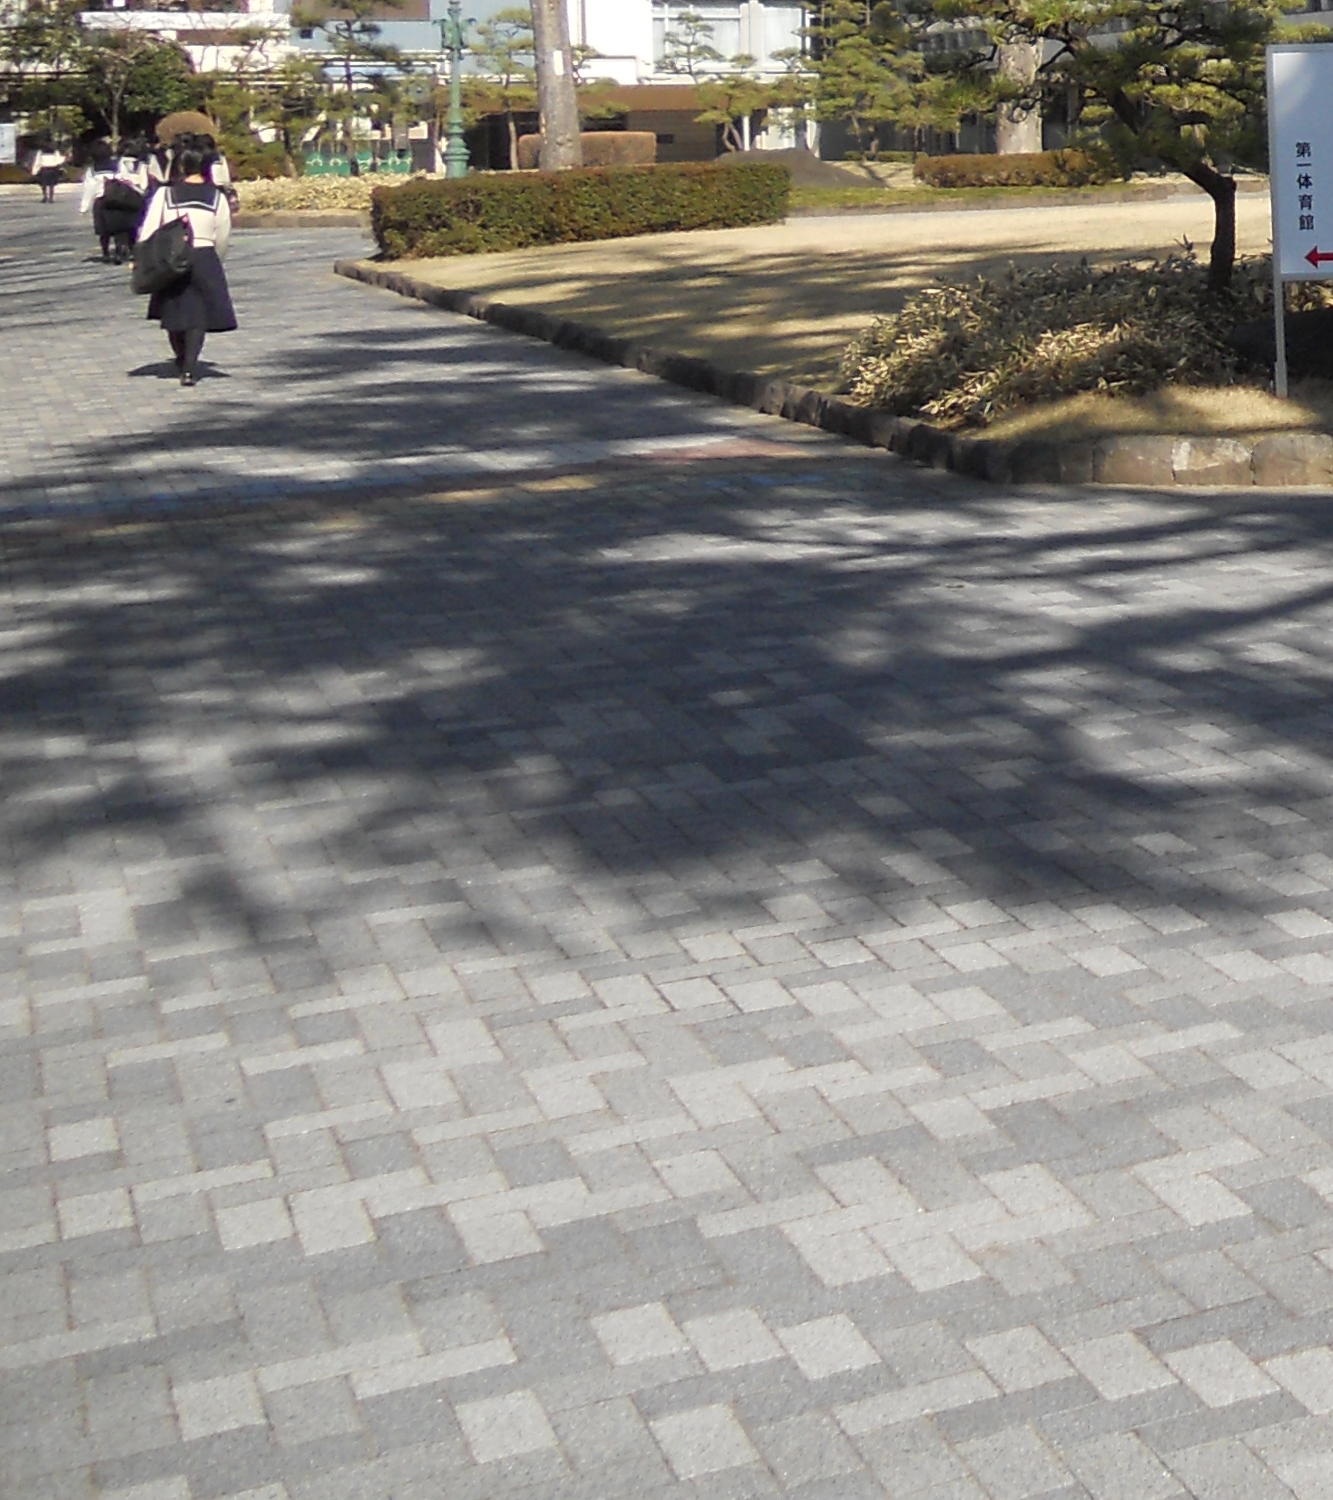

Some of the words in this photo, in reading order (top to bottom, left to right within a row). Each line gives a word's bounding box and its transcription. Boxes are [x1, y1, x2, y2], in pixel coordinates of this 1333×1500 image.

[1295, 142, 1314, 230] 第一体育館
